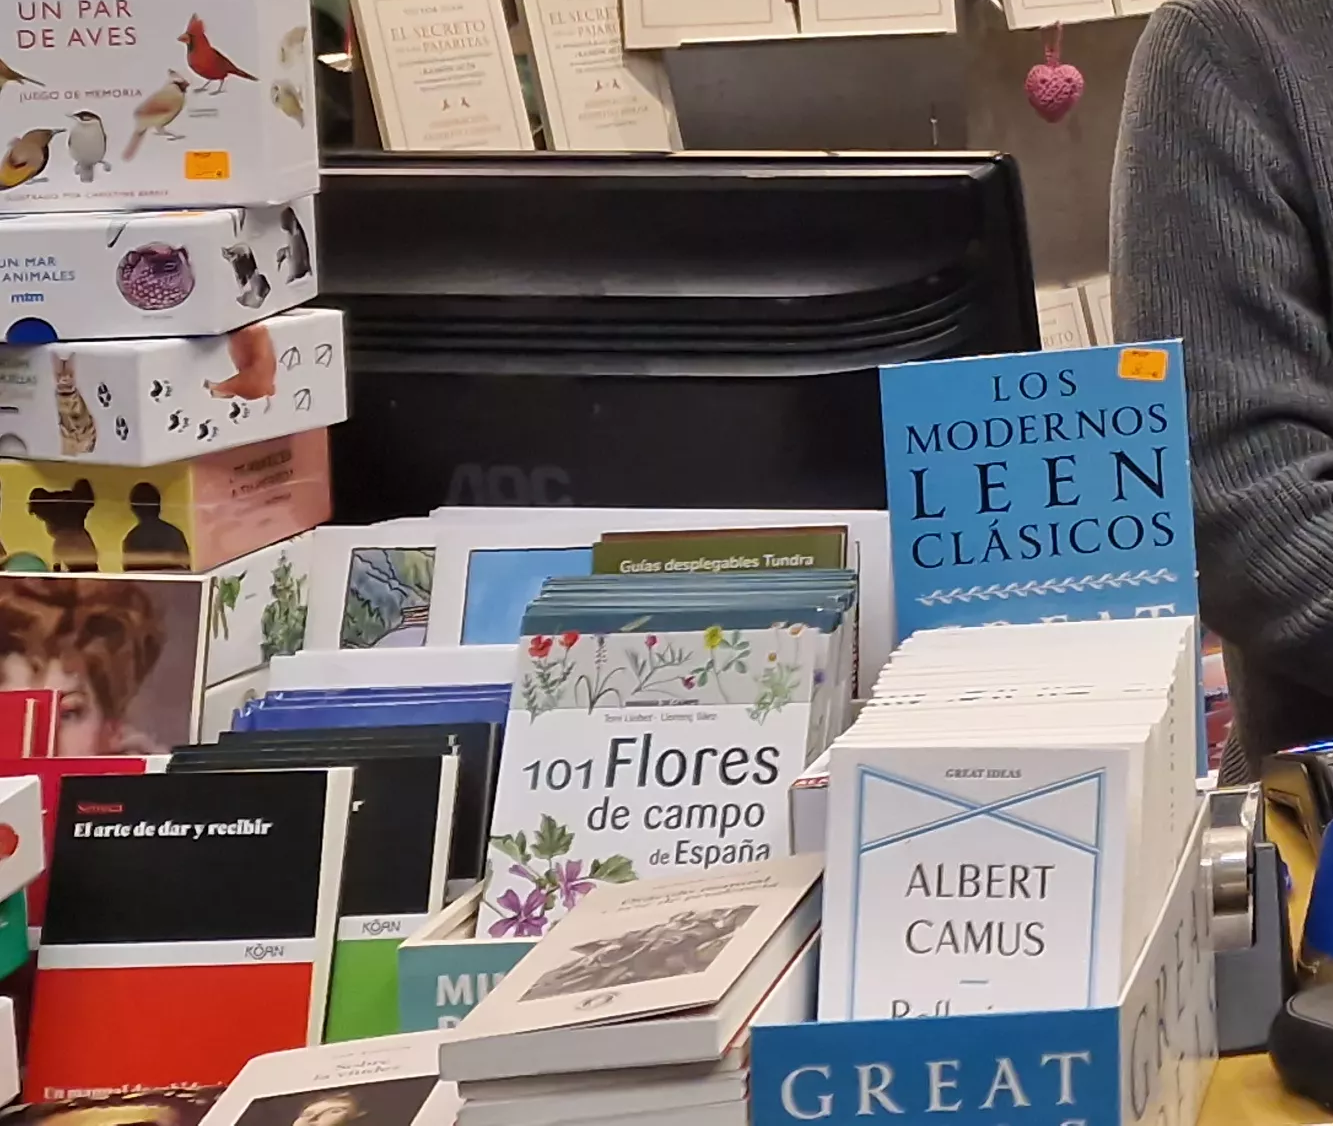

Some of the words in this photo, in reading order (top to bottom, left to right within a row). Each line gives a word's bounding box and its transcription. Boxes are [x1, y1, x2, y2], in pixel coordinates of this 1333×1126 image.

[17, 0, 62, 21] UN
[568, 6, 618, 23] SECRE
[16, 28, 56, 49] DE
[67, 25, 138, 47] AVES
[390, 26, 408, 42] EL
[412, 18, 487, 40] SECRETO
[19, 90, 60, 103] JUEGO
[64, 89, 81, 100] DE
[84, 87, 143, 100] MEMORIA
[24, 256, 57, 268] MAR
[1043, 329, 1075, 347] RETO
[991, 368, 1079, 404] LOS
[904, 402, 1169, 455] MODERNOS
[908, 445, 1169, 522] LEEN
[911, 510, 1176, 570] CLÁSICOS
[619, 559, 662, 574] Guías
[664, 554, 760, 574] desplegables
[762, 553, 815, 568] Tundra
[521, 758, 595, 792] 101
[604, 731, 781, 790] Flores
[944, 768, 984, 780] GREAT
[986, 768, 1023, 780] IDEAS
[73, 821, 92, 838] El
[93, 822, 131, 838] arte
[133, 820, 157, 837] de
[157, 820, 192, 837] dar
[193, 821, 206, 840] y
[207, 817, 274, 837] recibir
[586, 795, 631, 831] de
[642, 801, 767, 839] campo
[649, 848, 671, 867] de
[674, 838, 772, 870] España
[903, 862, 1057, 900] ALBERT
[903, 918, 1047, 959] CAMUS
[779, 1050, 1092, 1122] GREAT
